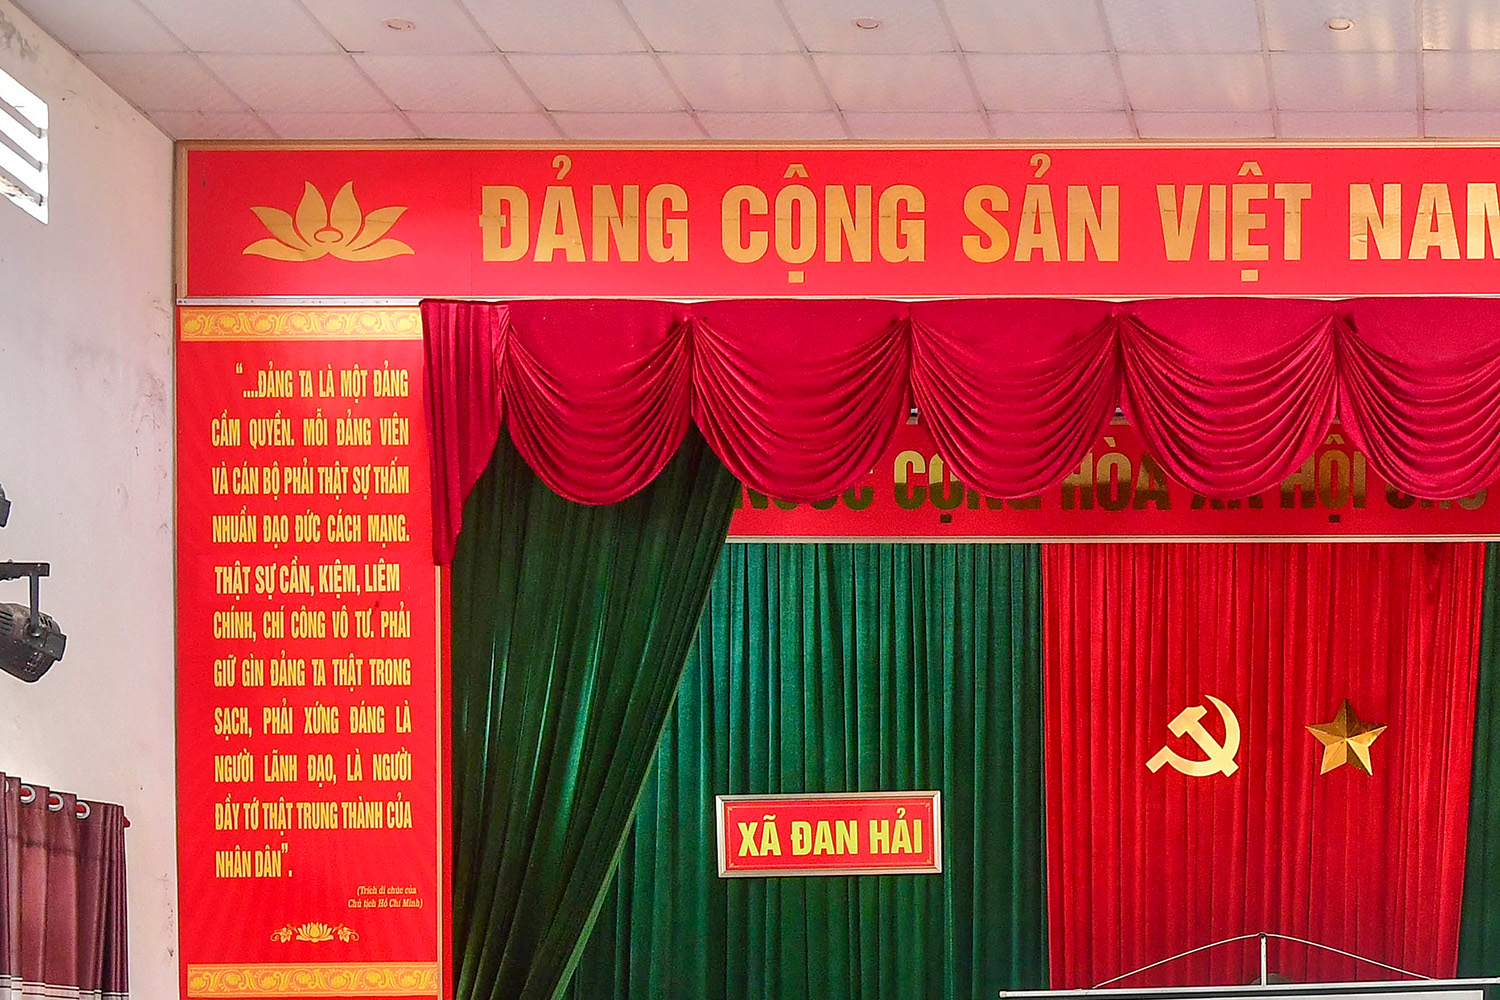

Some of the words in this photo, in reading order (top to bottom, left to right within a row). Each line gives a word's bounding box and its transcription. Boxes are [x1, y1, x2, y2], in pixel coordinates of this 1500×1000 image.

[479, 155, 688, 262] ĐẢNG
[722, 163, 925, 283] CỘNG
[962, 154, 1119, 262] SẢN
[1157, 162, 1311, 282] VIỆT
[299, 370, 313, 397] TA
[319, 364, 335, 397] LÀ
[341, 364, 367, 403] MỘT
[373, 360, 408, 397] ĐẢNG
[212, 409, 240, 446] CẦM
[250, 410, 294, 449] QUYỀN.
[304, 409, 327, 446] MỖI
[336, 409, 371, 445] ĐẢNG
[380, 412, 408, 445] VIÊN
[213, 506, 256, 542] NHUẦN
[263, 515, 288, 548] ĐẠO
[295, 509, 320, 542] ĐỨC
[328, 509, 361, 542] CÁCH
[368, 514, 409, 548] MẠNG.
[215, 561, 250, 600] THẬT
[255, 563, 276, 599] SỰ
[280, 556, 314, 596] CẦN,
[319, 559, 360, 598] KIỆM,
[365, 558, 399, 591] LIÊM
[215, 707, 252, 740] SẠCH,
[264, 698, 292, 734] PHẢI
[304, 701, 339, 734] XỨNG
[350, 701, 384, 733] ĐÁNG
[396, 700, 411, 732] LÀ
[738, 812, 782, 857] XÃ
[790, 820, 859, 855] ĐAN
[869, 807, 923, 854] HẢI
[216, 845, 251, 877] NHÂN
